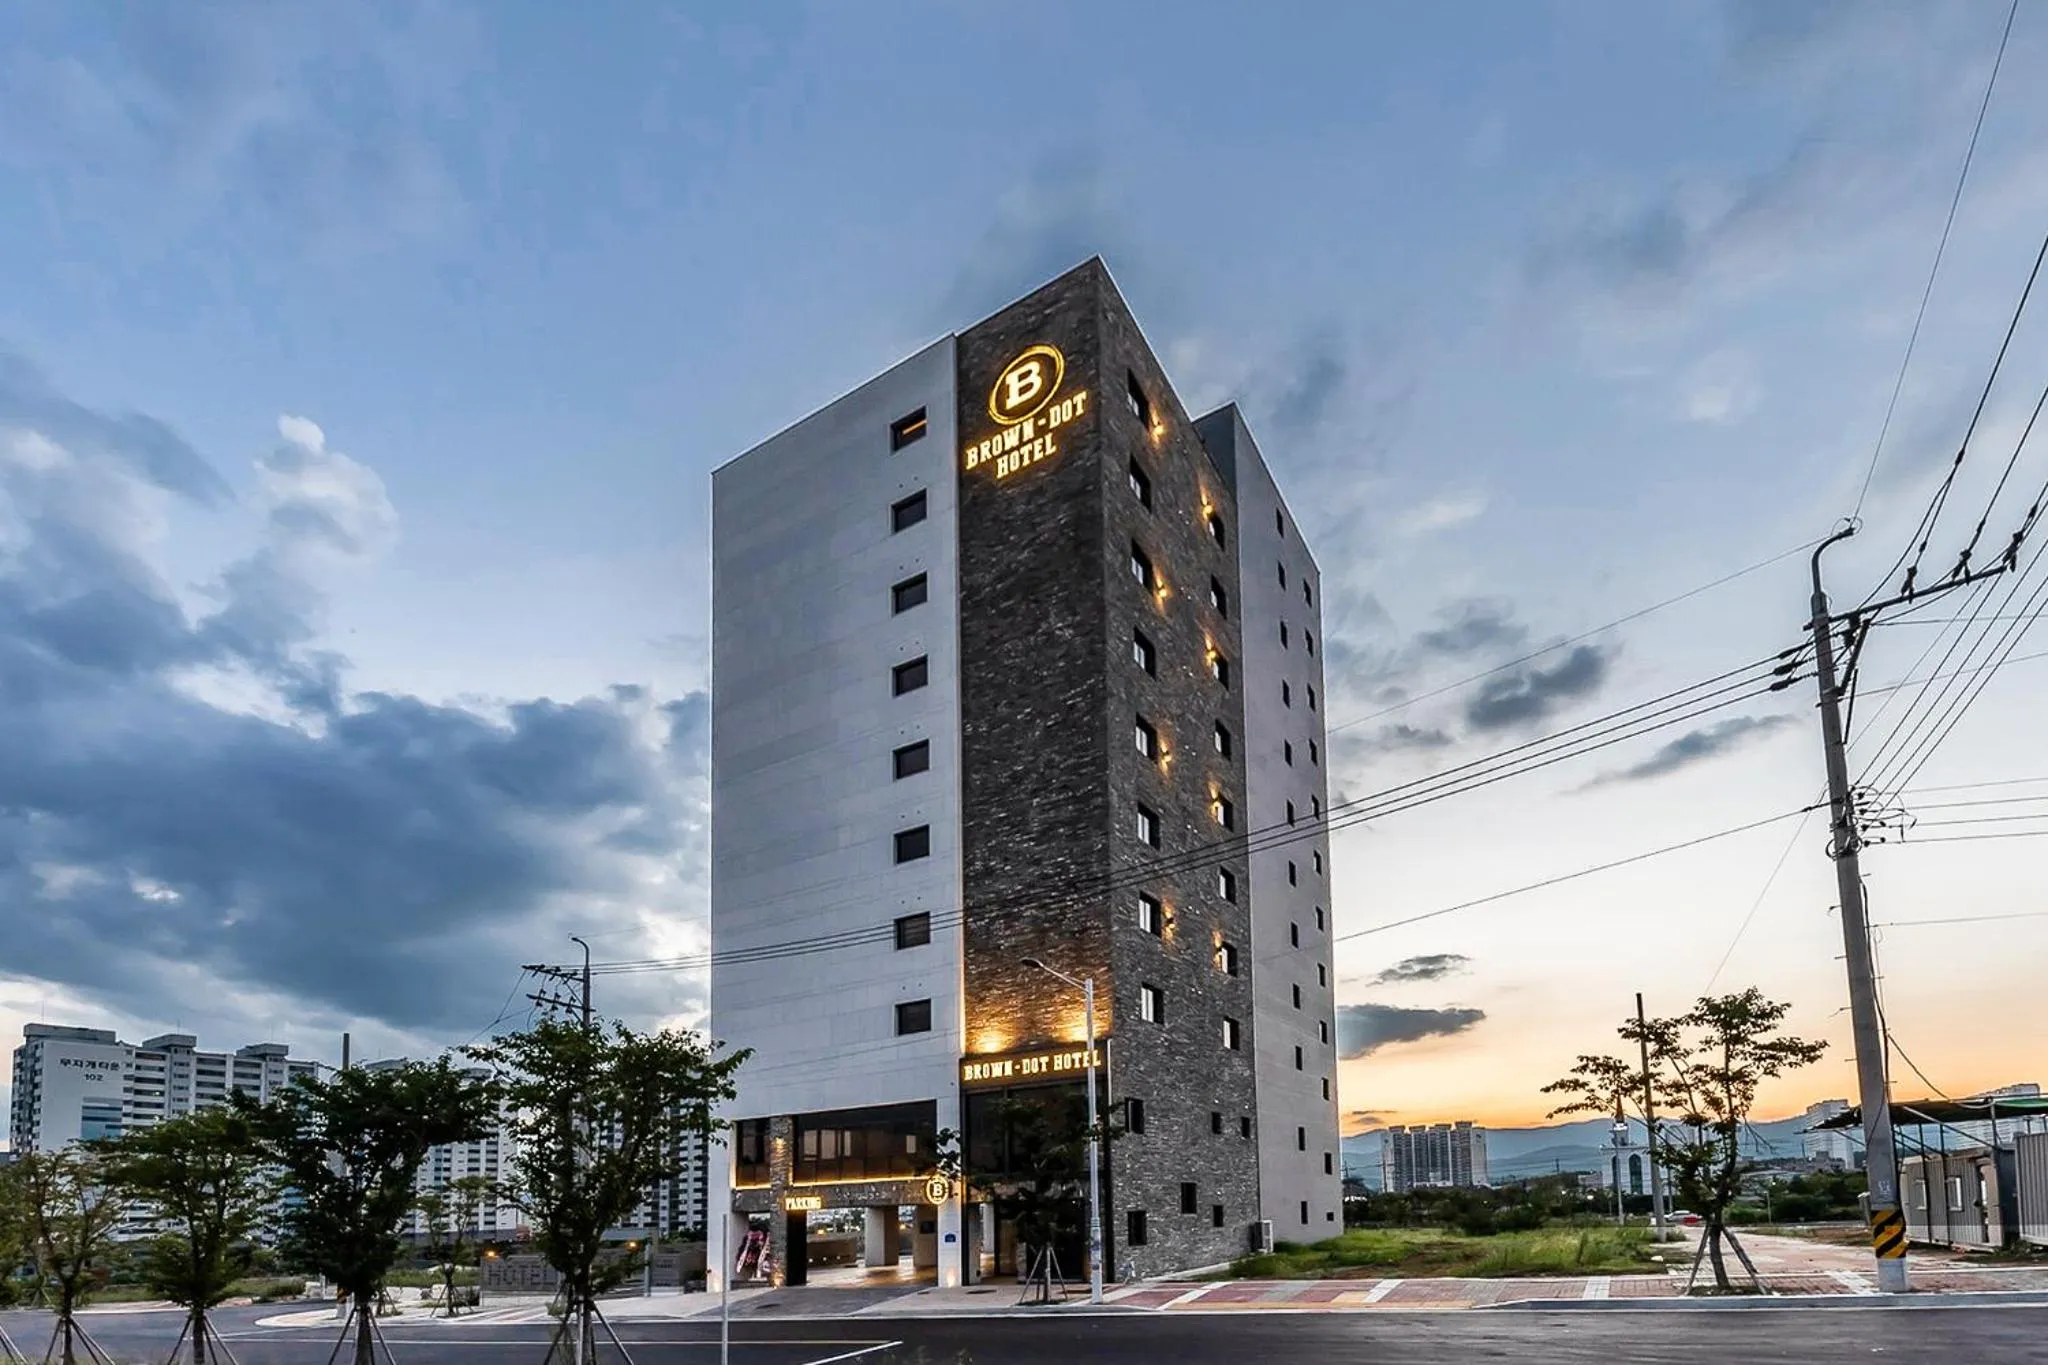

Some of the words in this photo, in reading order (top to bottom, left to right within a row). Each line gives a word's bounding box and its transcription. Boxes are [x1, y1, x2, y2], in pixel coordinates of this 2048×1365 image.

[1005, 361, 1042, 410] B
[996, 432, 1057, 479] HOTEL
[1053, 1049, 1102, 1071] HOTEL
[85, 1073, 104, 1081] 102
[785, 1196, 822, 1210] PARKING
